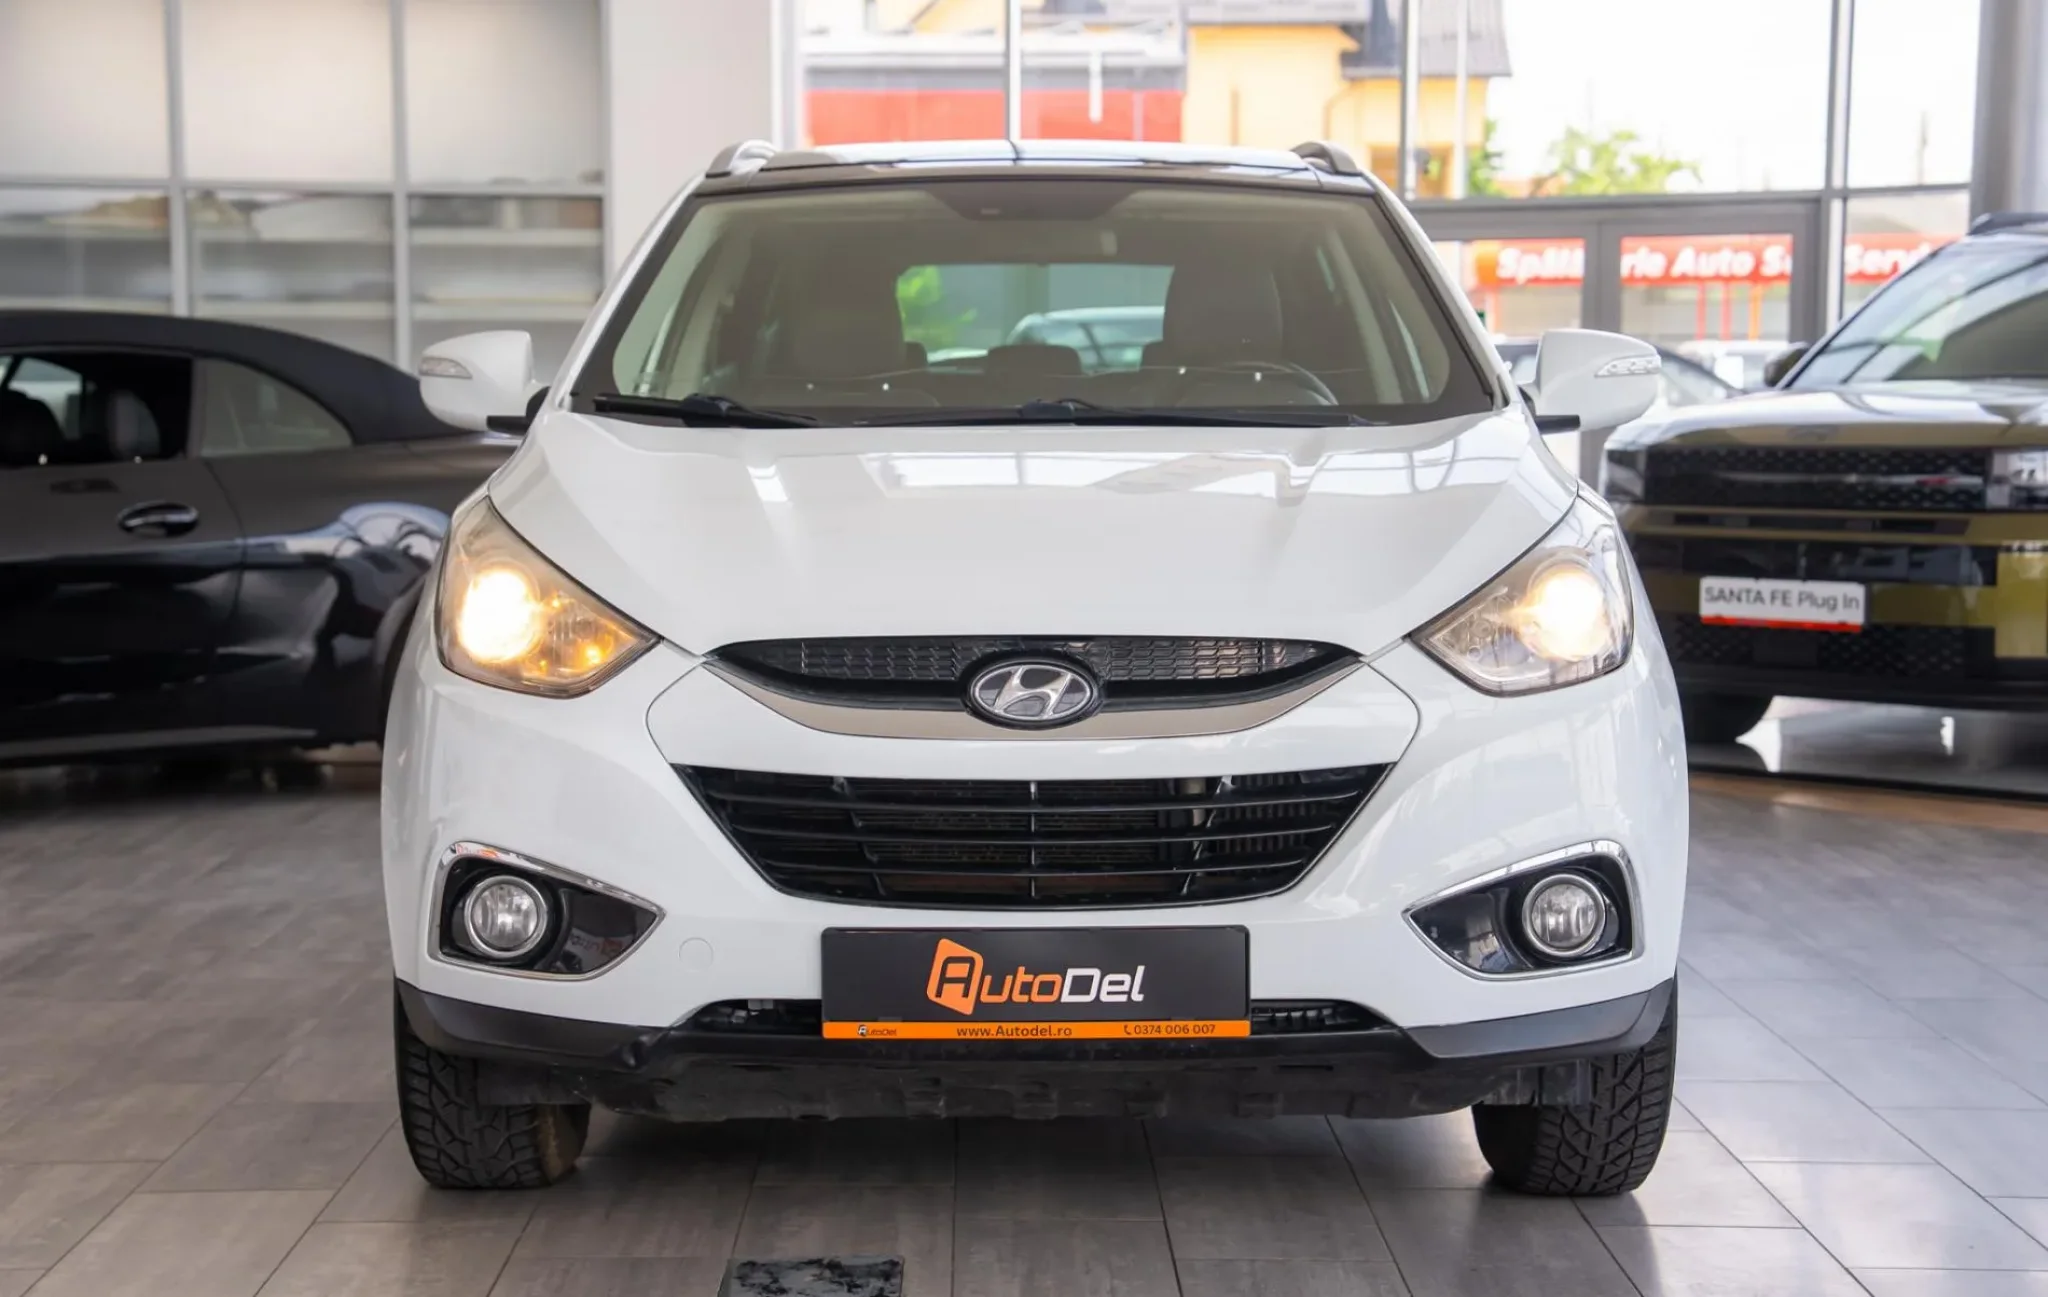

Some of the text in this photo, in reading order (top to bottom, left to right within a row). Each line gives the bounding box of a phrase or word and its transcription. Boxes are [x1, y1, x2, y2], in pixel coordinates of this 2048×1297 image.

[1673, 247, 1753, 276] Auto
[1705, 586, 1859, 612] SANTA FE Plug In
[932, 949, 1145, 1006] AutoDel
[957, 1025, 1072, 1037] www.Autodel.ro
[1134, 1024, 1216, 1035] 0374 006 007
